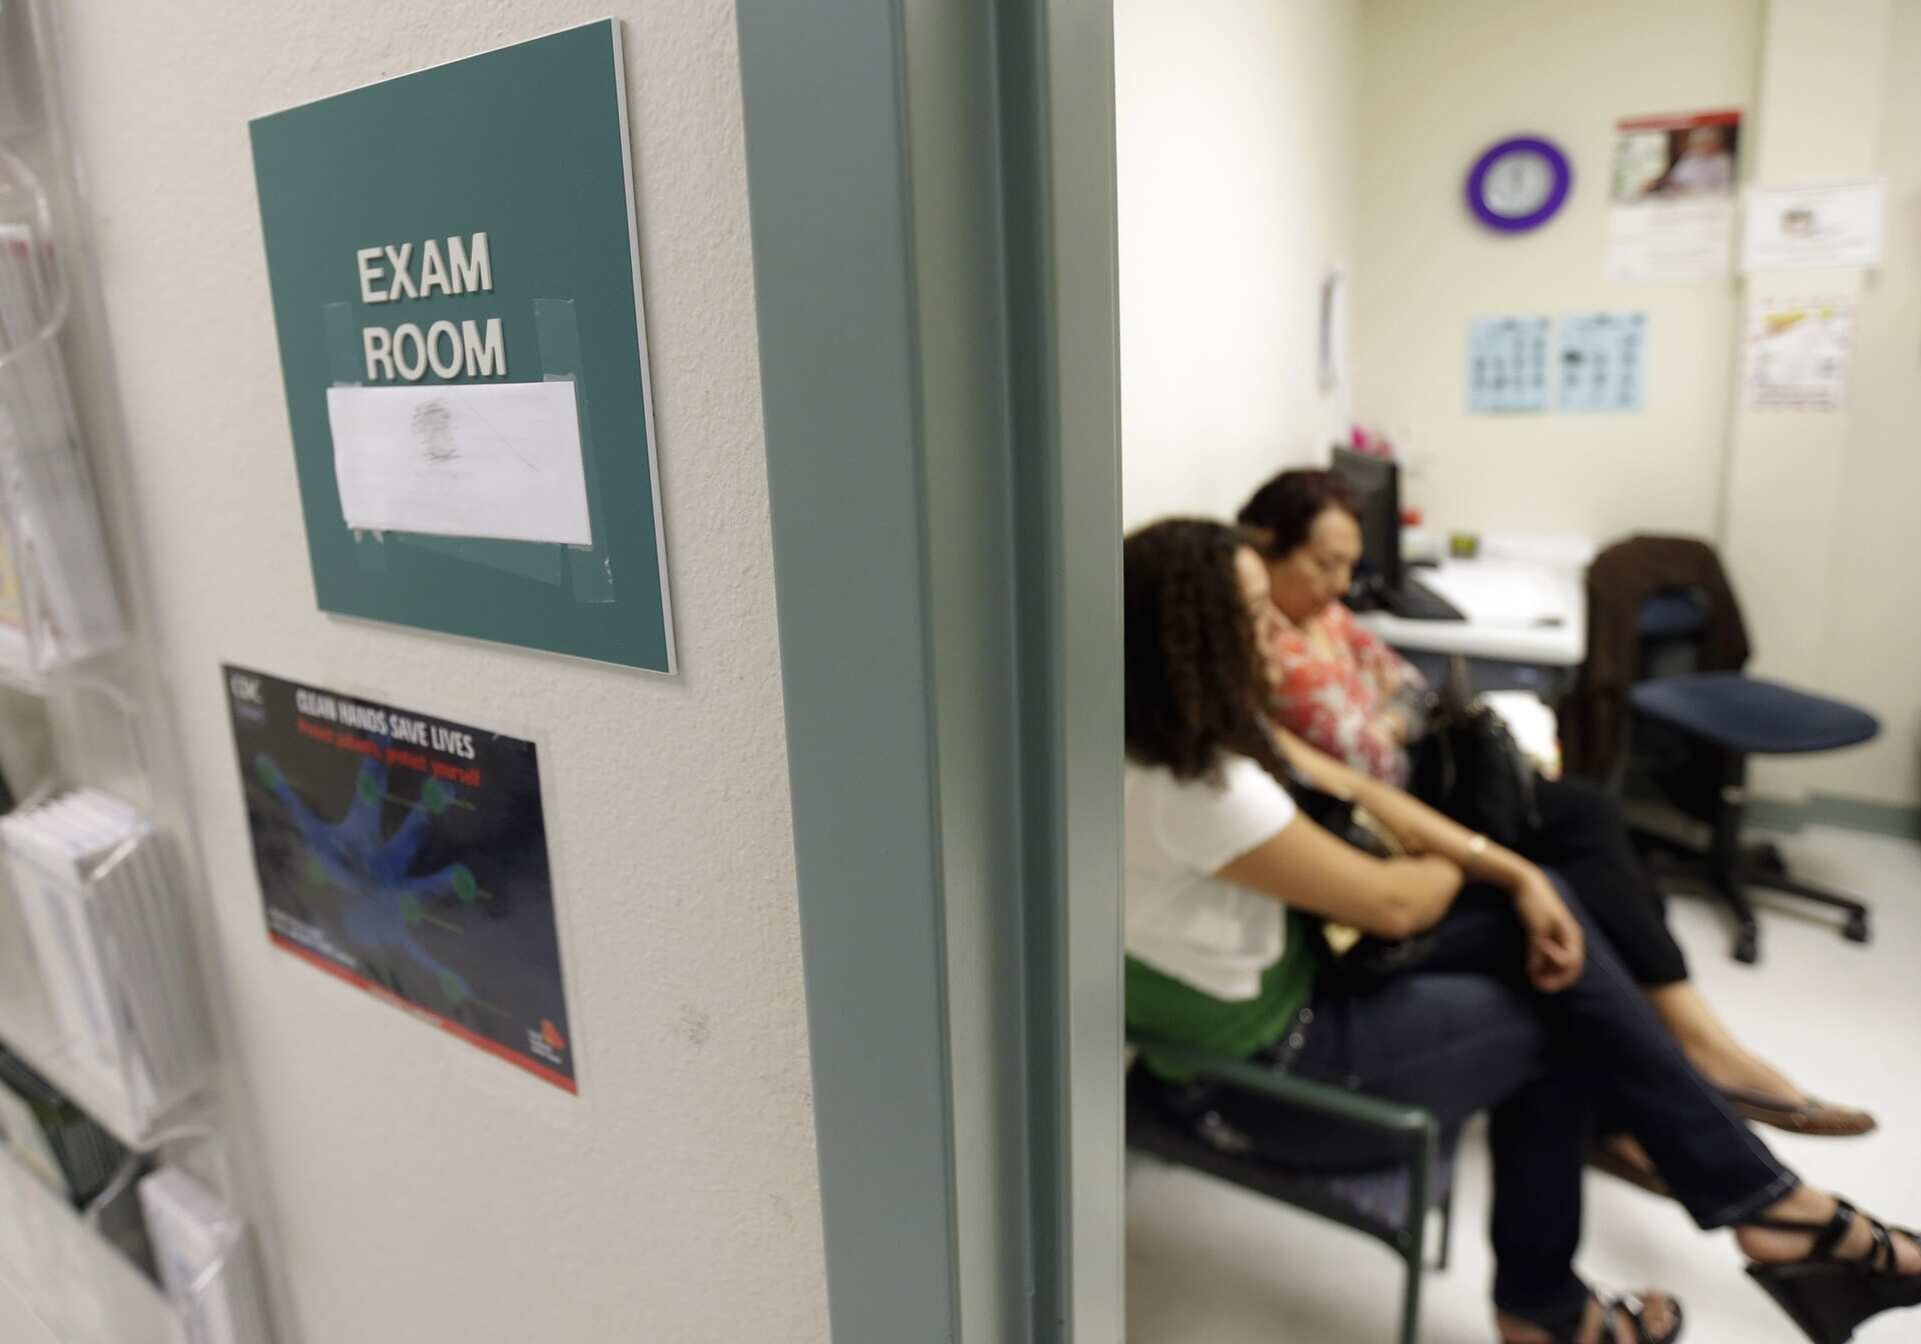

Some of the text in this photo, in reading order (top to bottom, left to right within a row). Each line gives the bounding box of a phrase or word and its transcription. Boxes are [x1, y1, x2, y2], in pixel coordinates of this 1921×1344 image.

[357, 232, 493, 303] EXAM
[363, 318, 507, 381] ROOM
[296, 688, 337, 720] CLEAN
[338, 701, 389, 736] HANDS
[389, 714, 429, 747] SAVE
[430, 725, 476, 760] LIVES
